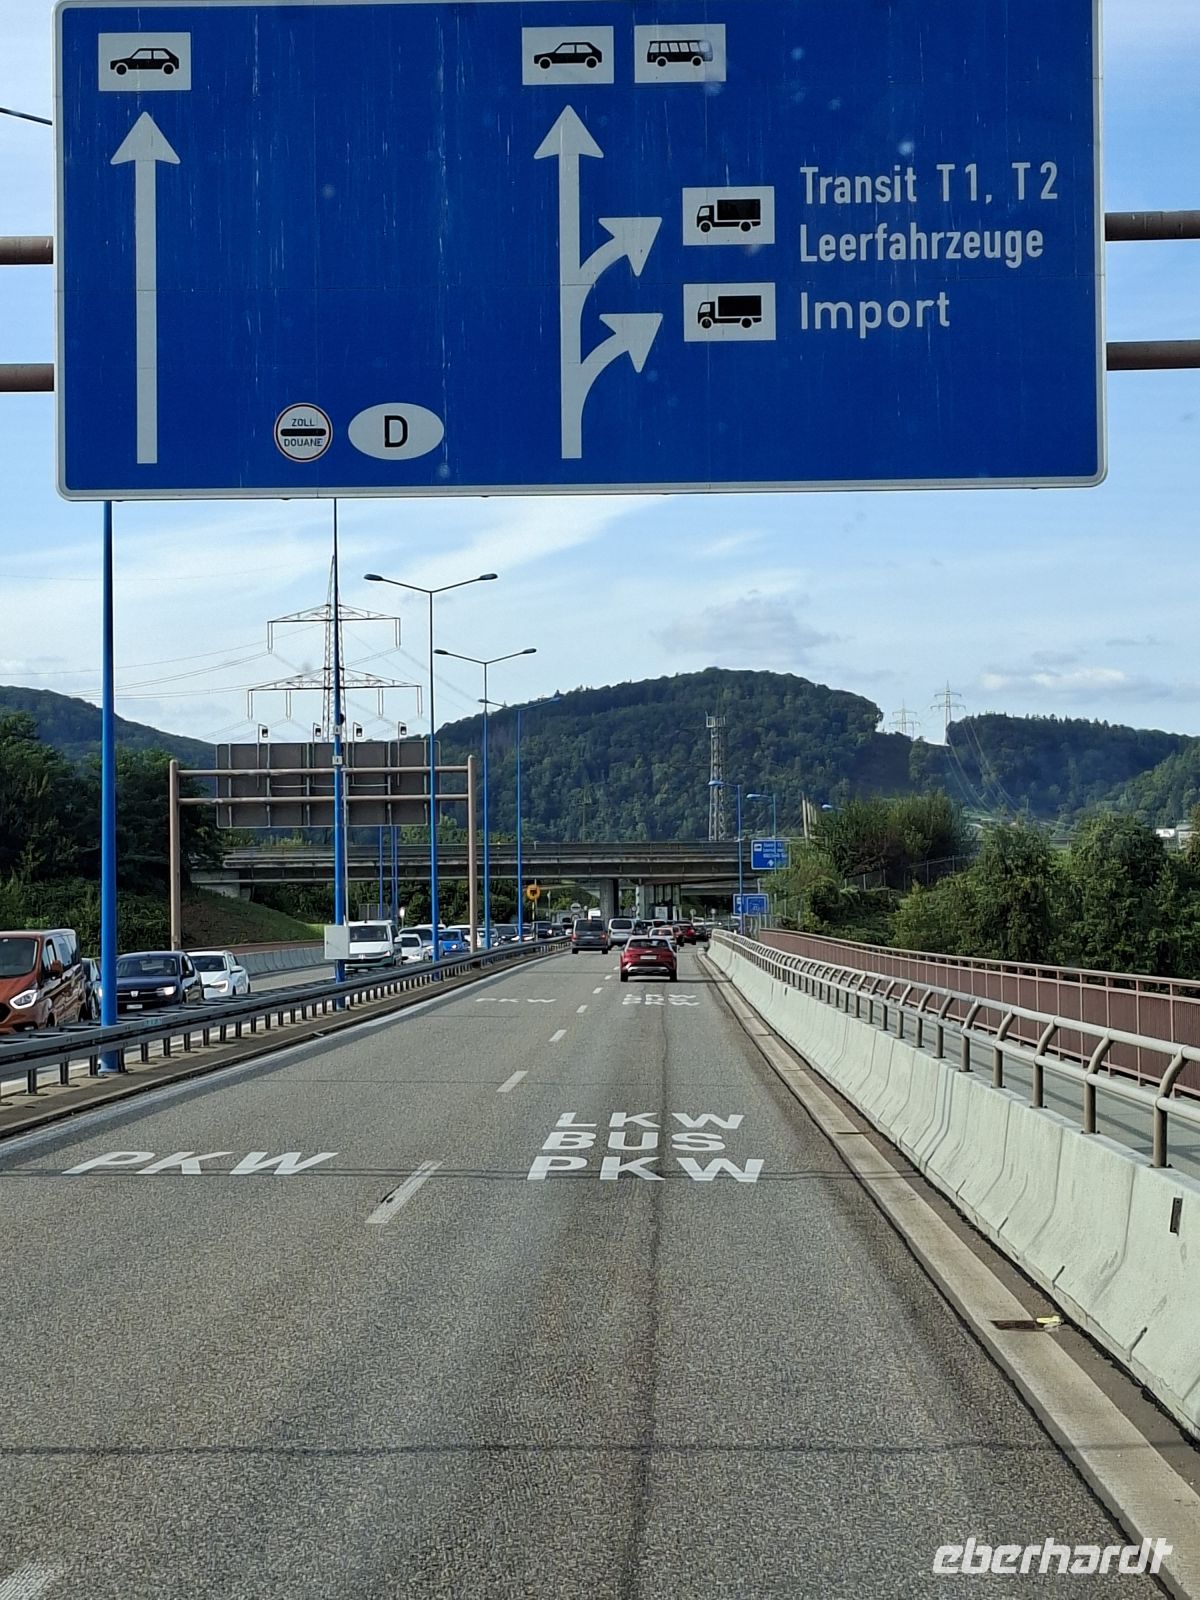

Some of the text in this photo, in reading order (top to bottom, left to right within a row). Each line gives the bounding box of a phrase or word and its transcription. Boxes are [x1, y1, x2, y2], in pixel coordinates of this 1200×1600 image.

[800, 165, 917, 204] Transit
[800, 222, 1044, 268] Leerfahrzeuge
[801, 292, 950, 339] Import
[291, 418, 316, 427] ZOLL
[384, 415, 408, 448] D
[284, 438, 323, 447] DOUANE
[555, 1112, 745, 1129] LKW
[541, 1131, 726, 1150] BUS
[61, 1151, 339, 1175] PKW
[527, 1155, 765, 1182] PKW
